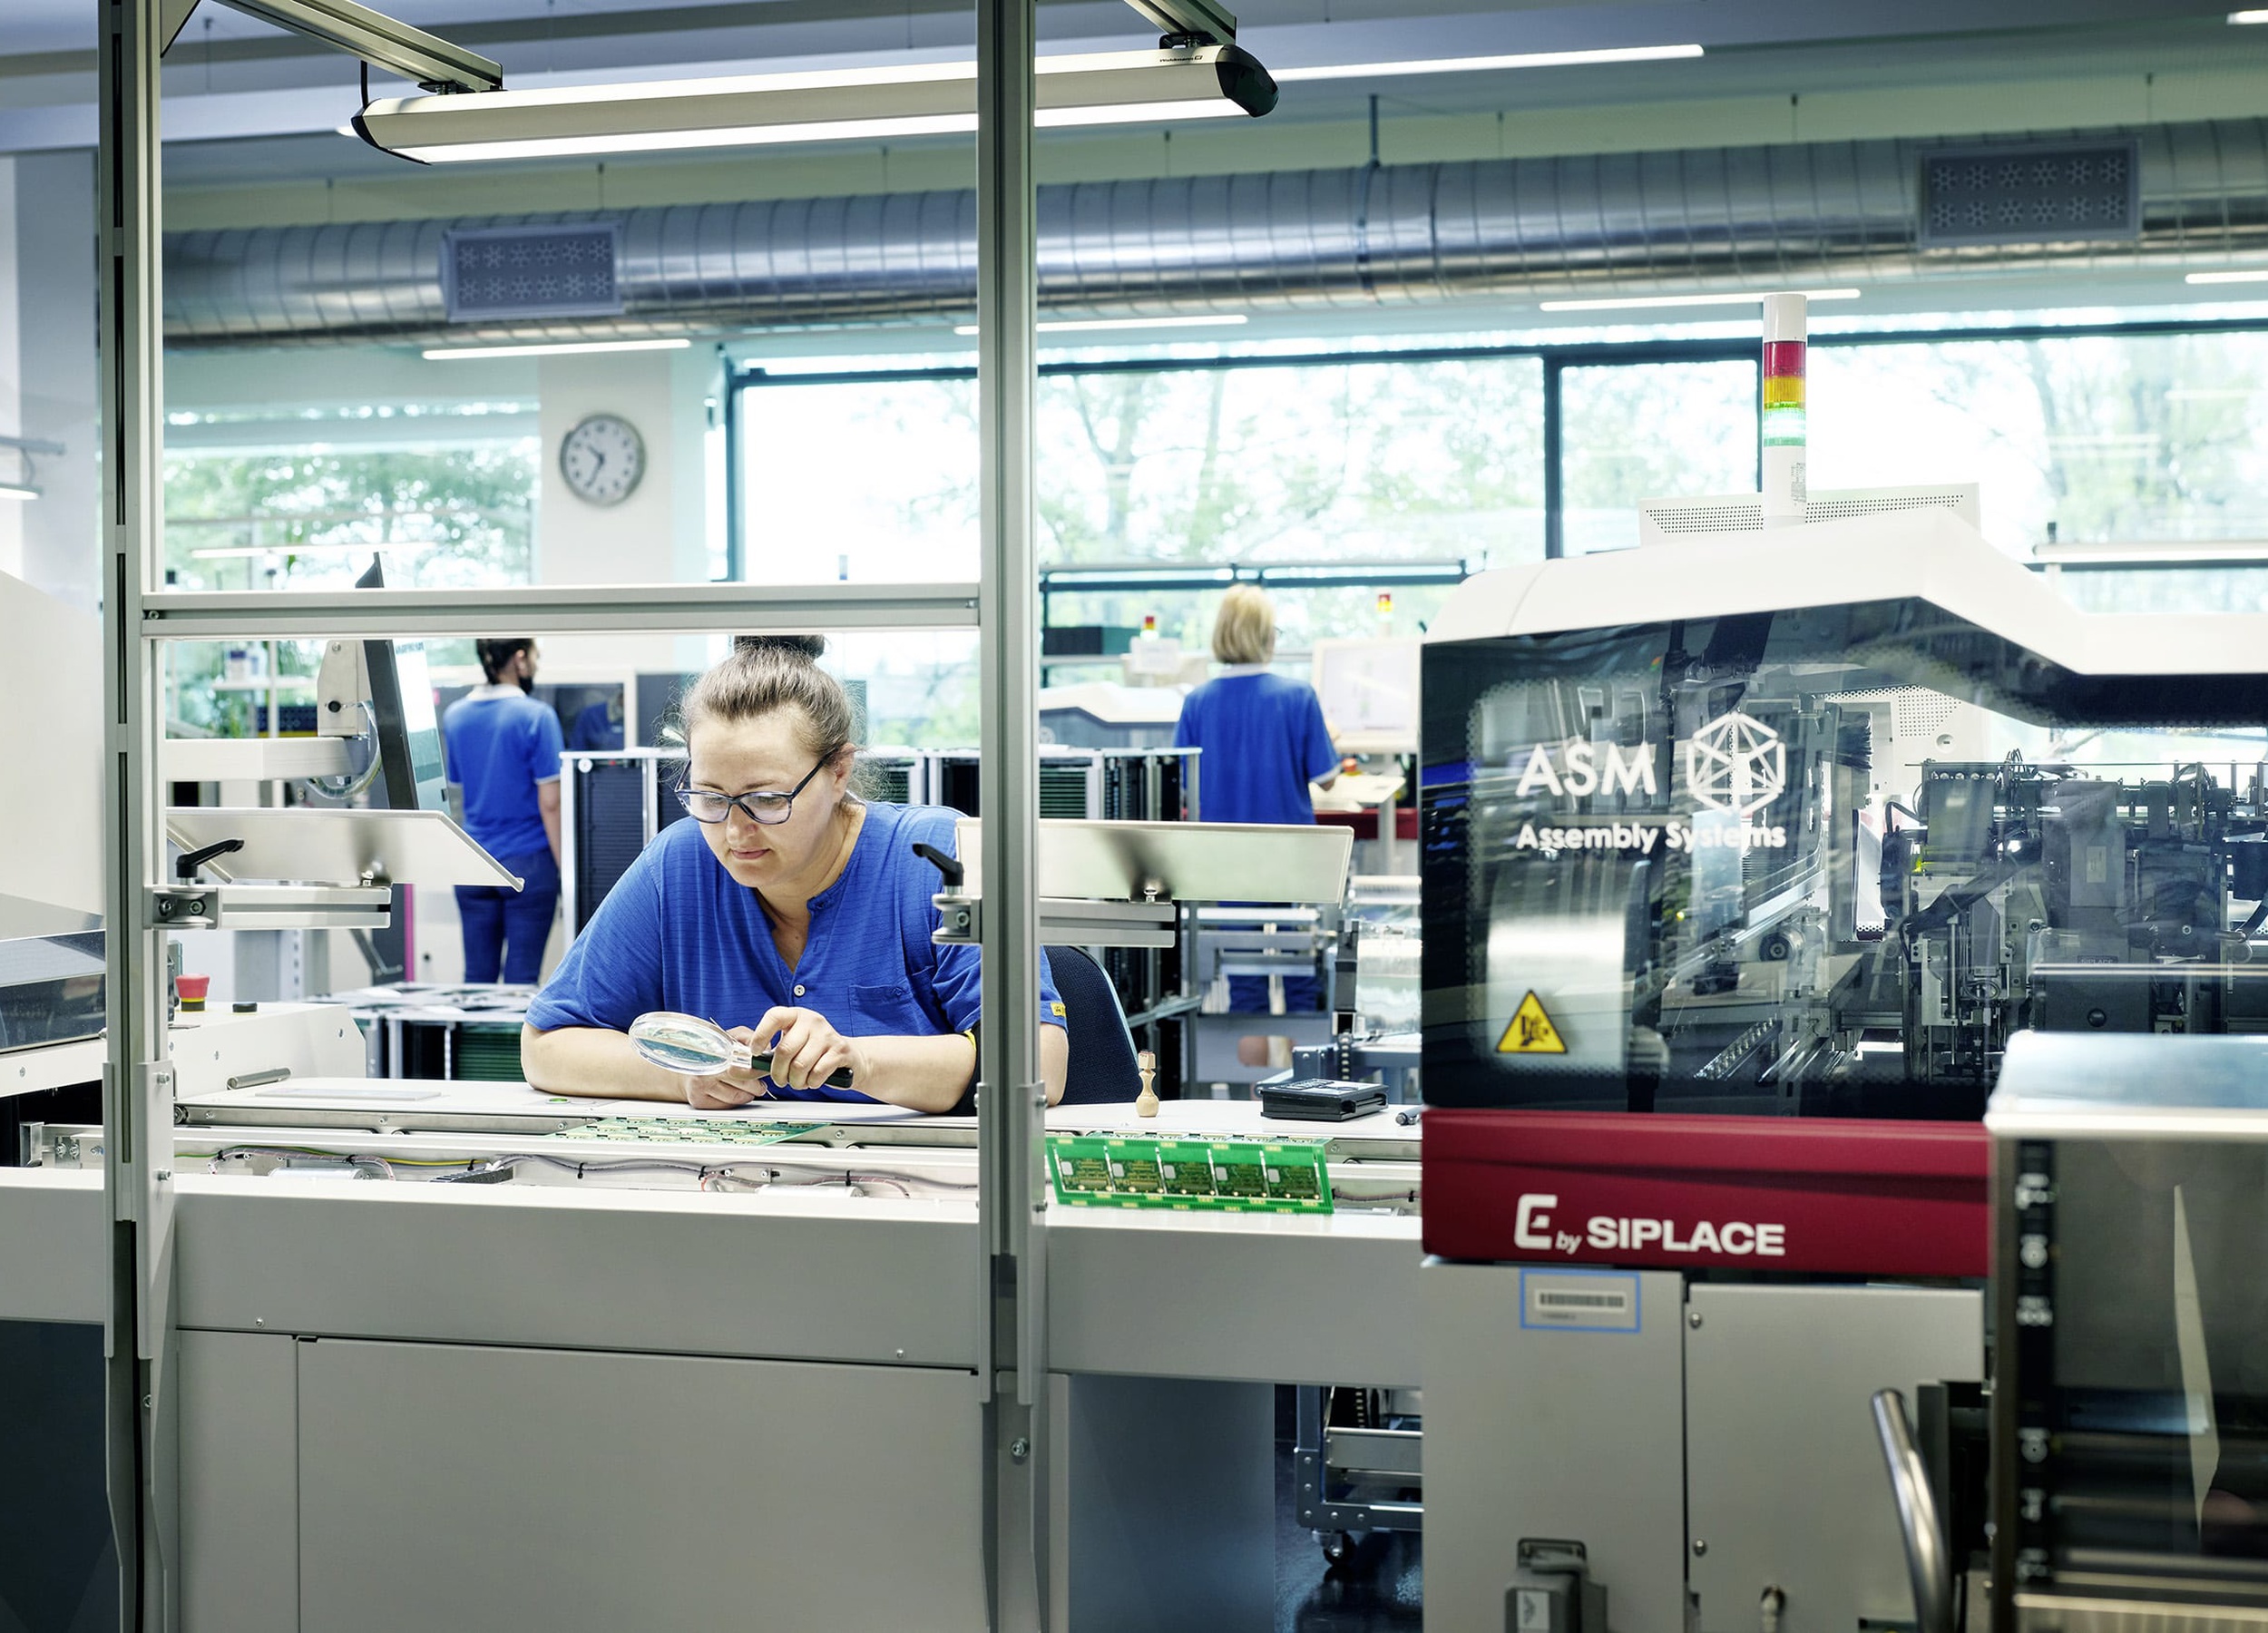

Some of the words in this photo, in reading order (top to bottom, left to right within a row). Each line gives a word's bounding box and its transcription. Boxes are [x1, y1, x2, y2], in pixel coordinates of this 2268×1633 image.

[1516, 742, 1657, 797] ASM
[1516, 822, 1658, 854] Assembly
[1665, 822, 1787, 854] Systems
[1514, 1194, 1558, 1250] E
[1555, 1230, 1582, 1255] by
[1587, 1216, 1786, 1256] SIPLACE
